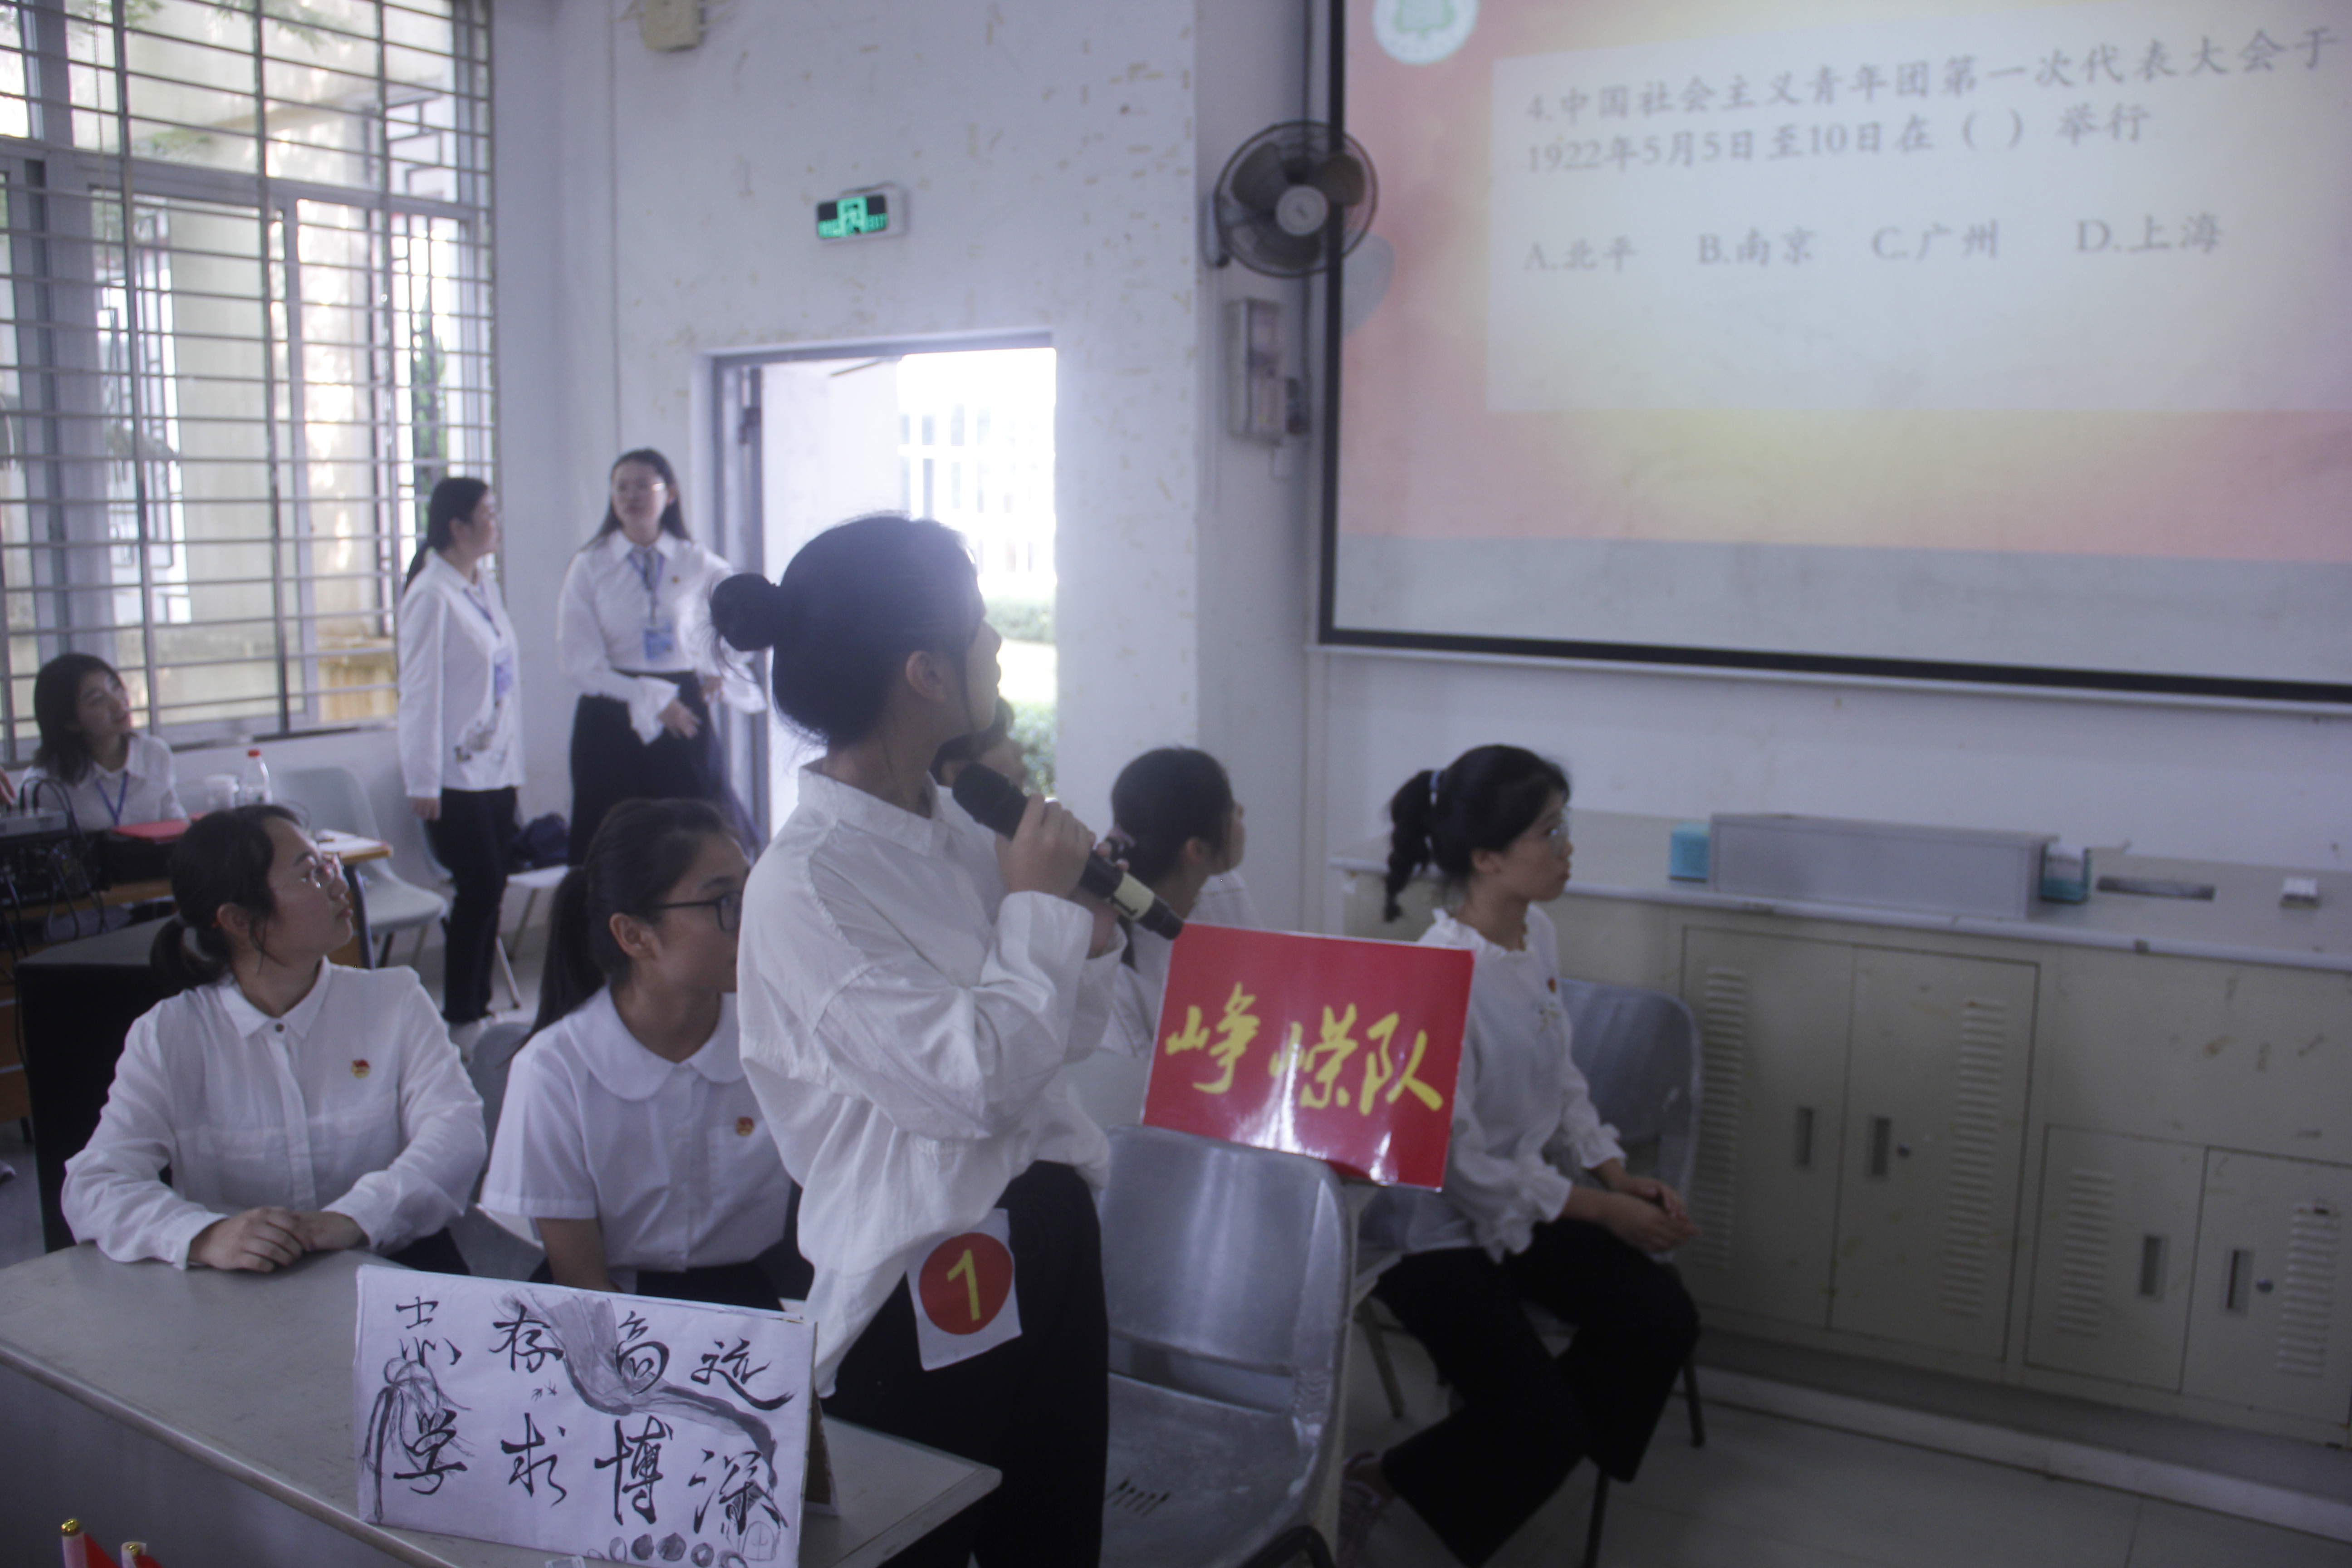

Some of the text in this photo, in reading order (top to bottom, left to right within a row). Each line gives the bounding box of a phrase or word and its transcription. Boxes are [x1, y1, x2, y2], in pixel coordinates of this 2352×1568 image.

[1698, 227, 1815, 266] B.南京
[1871, 219, 2000, 261] C.广州
[2075, 211, 2223, 254] D.上海
[1165, 981, 1445, 1116] 峥嵘队
[946, 1248, 981, 1322] 1
[394, 1295, 794, 1411] 志存高远
